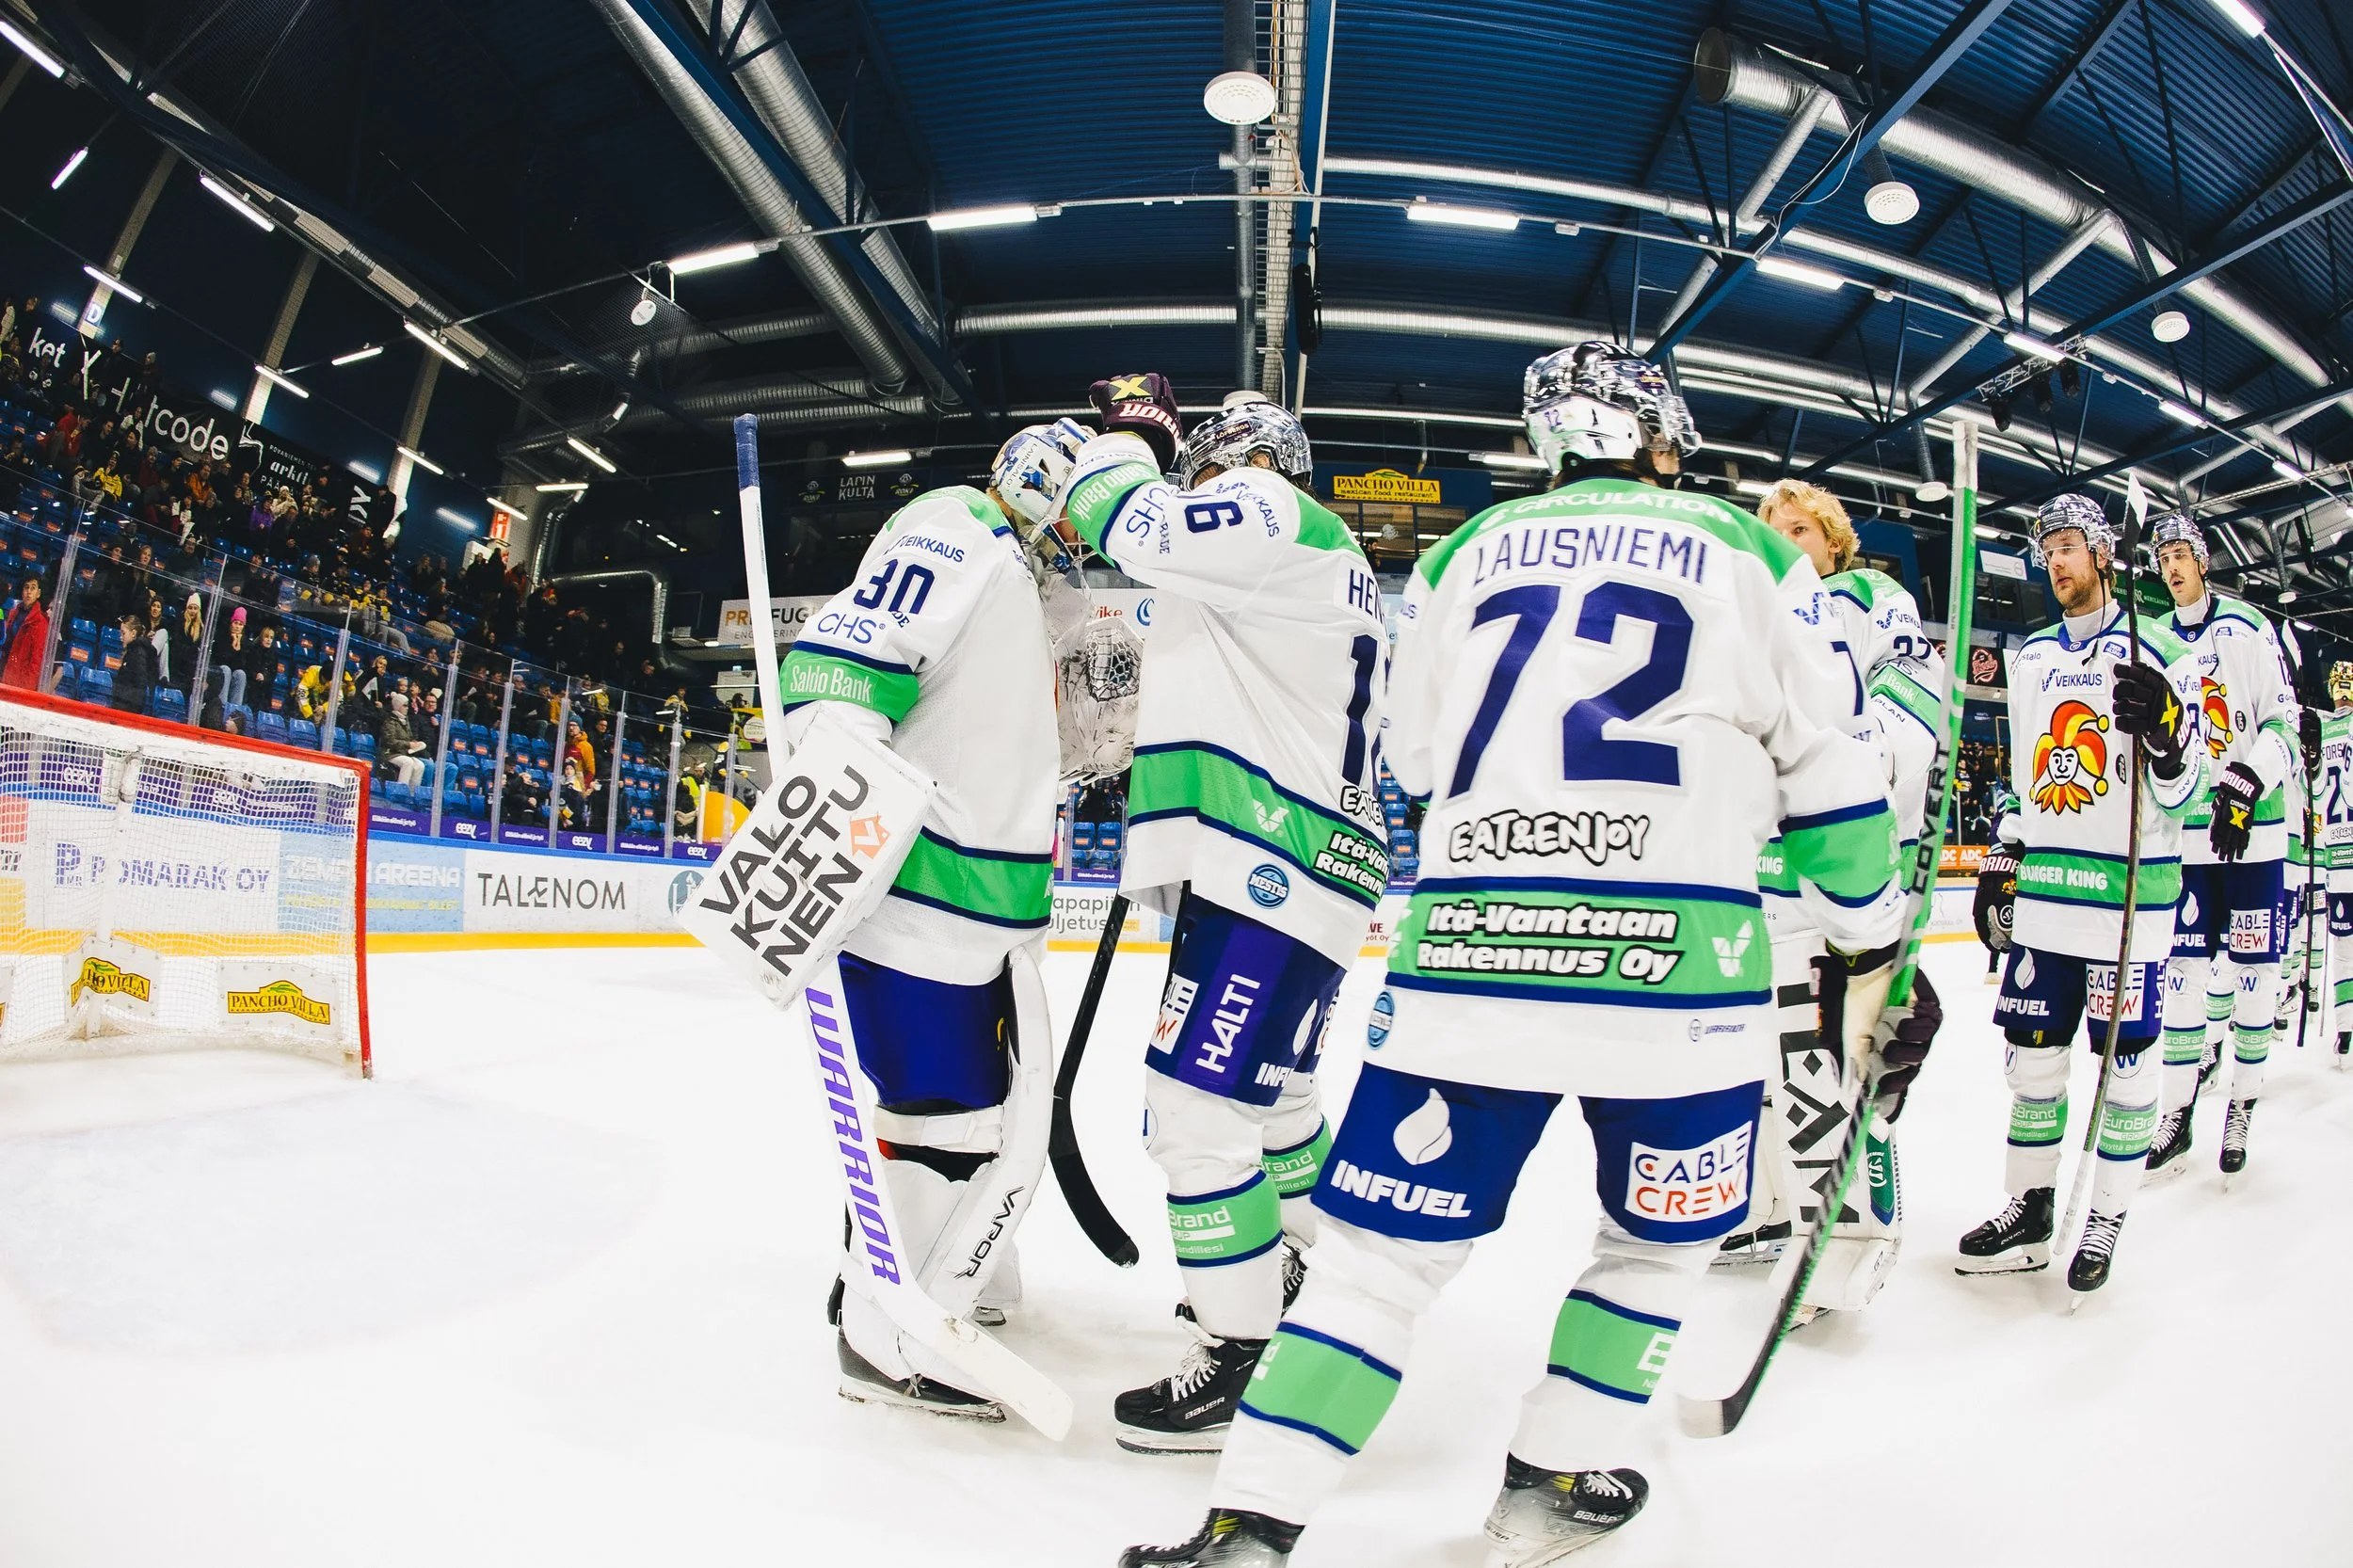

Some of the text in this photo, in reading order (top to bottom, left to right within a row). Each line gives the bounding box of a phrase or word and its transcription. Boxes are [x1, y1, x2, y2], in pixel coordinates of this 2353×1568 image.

[838, 488, 874, 501] KULTA
[840, 475, 875, 487] LAPIN
[1337, 477, 1437, 492] PANCHO VILLA
[1394, 490, 1434, 499] restaurant
[1072, 479, 1112, 520] Bank
[1512, 491, 1734, 523] CIRCULATION
[1473, 524, 1708, 587] LAUSNIEMI
[817, 613, 877, 645] CHS
[790, 664, 873, 704] Saldo Bank
[1447, 580, 1694, 801] 72
[1886, 672, 1916, 702] Bank
[2056, 673, 2103, 687] VEIKKAUS
[456, 822, 477, 840] eezy
[571, 835, 593, 851] eezy
[699, 776, 817, 915] VALO
[1448, 808, 1651, 866] EAT&ENJOY
[687, 845, 708, 860] eezy
[729, 764, 870, 952] KUITU
[1960, 848, 1983, 862] ADC
[376, 861, 461, 888] AREENA
[477, 872, 627, 911] TALENOM
[2020, 864, 2108, 890] BURGER KING
[760, 851, 864, 977] NEN
[1427, 900, 1678, 940] Itä-Vantaan
[1417, 942, 1682, 984] Rakennus Oy
[107, 973, 146, 995] VILLA
[232, 993, 328, 1020] PANCHO VILLA
[1194, 973, 1261, 1074] HALTI
[805, 986, 902, 1287] WARRIOR
[1635, 1128, 1753, 1185] CABLE
[1329, 1159, 1471, 1219] INFUEL
[1636, 1167, 1744, 1216] CREW
